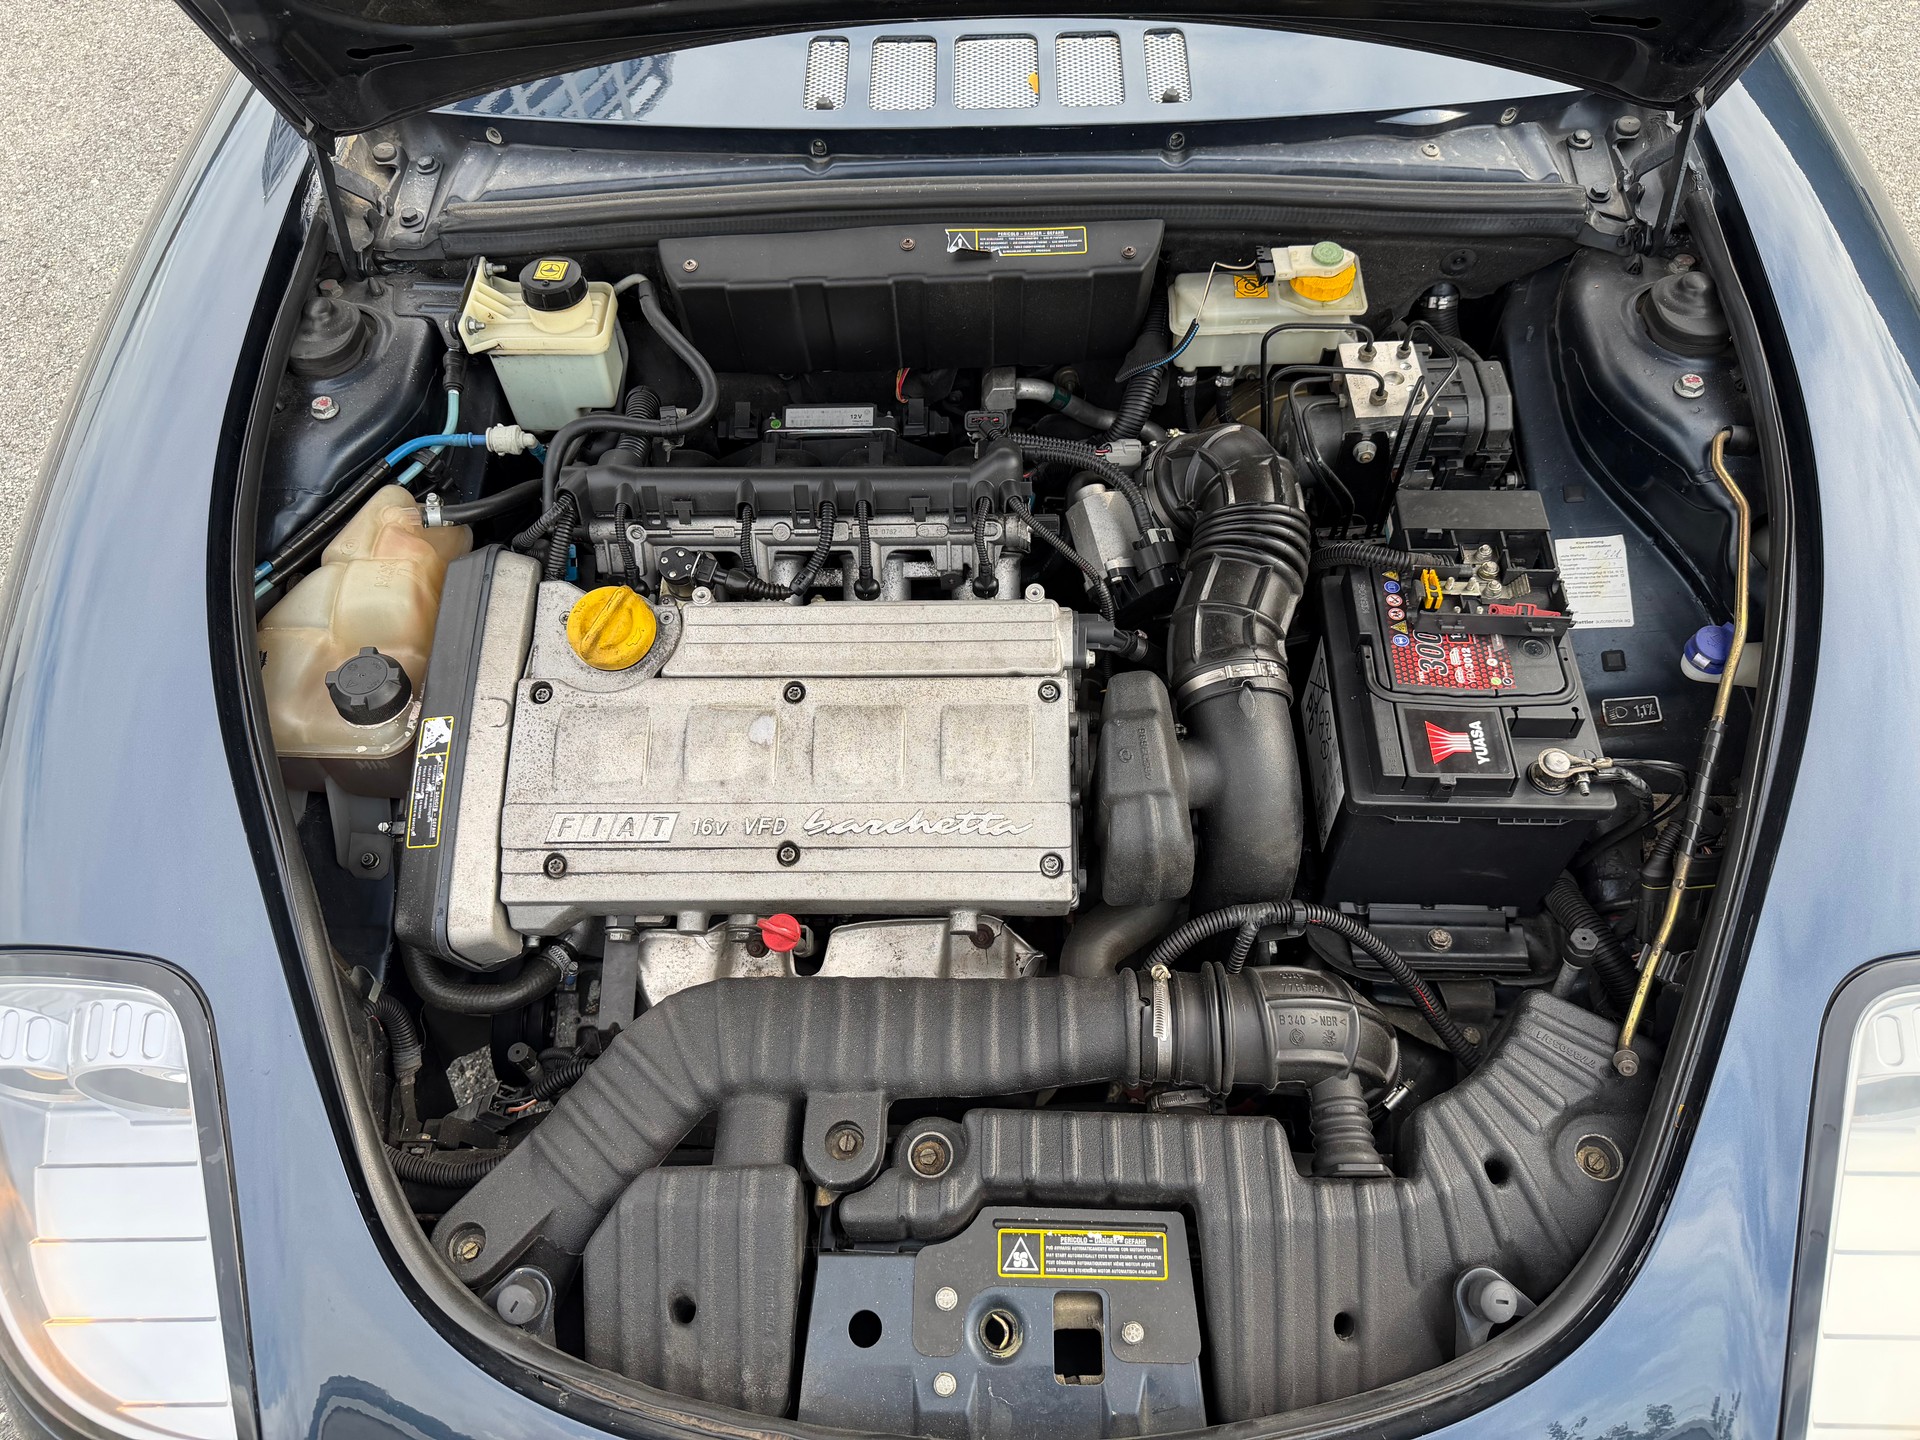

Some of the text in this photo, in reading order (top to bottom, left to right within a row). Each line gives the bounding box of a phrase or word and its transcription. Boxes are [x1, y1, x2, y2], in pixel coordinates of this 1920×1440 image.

[1461, 647, 1476, 684] YBX3012
[1634, 704, 1656, 718] 1,1%
[1468, 720, 1491, 765] YUASA
[557, 808, 1034, 838] FIAT 16v VFD barchetta
